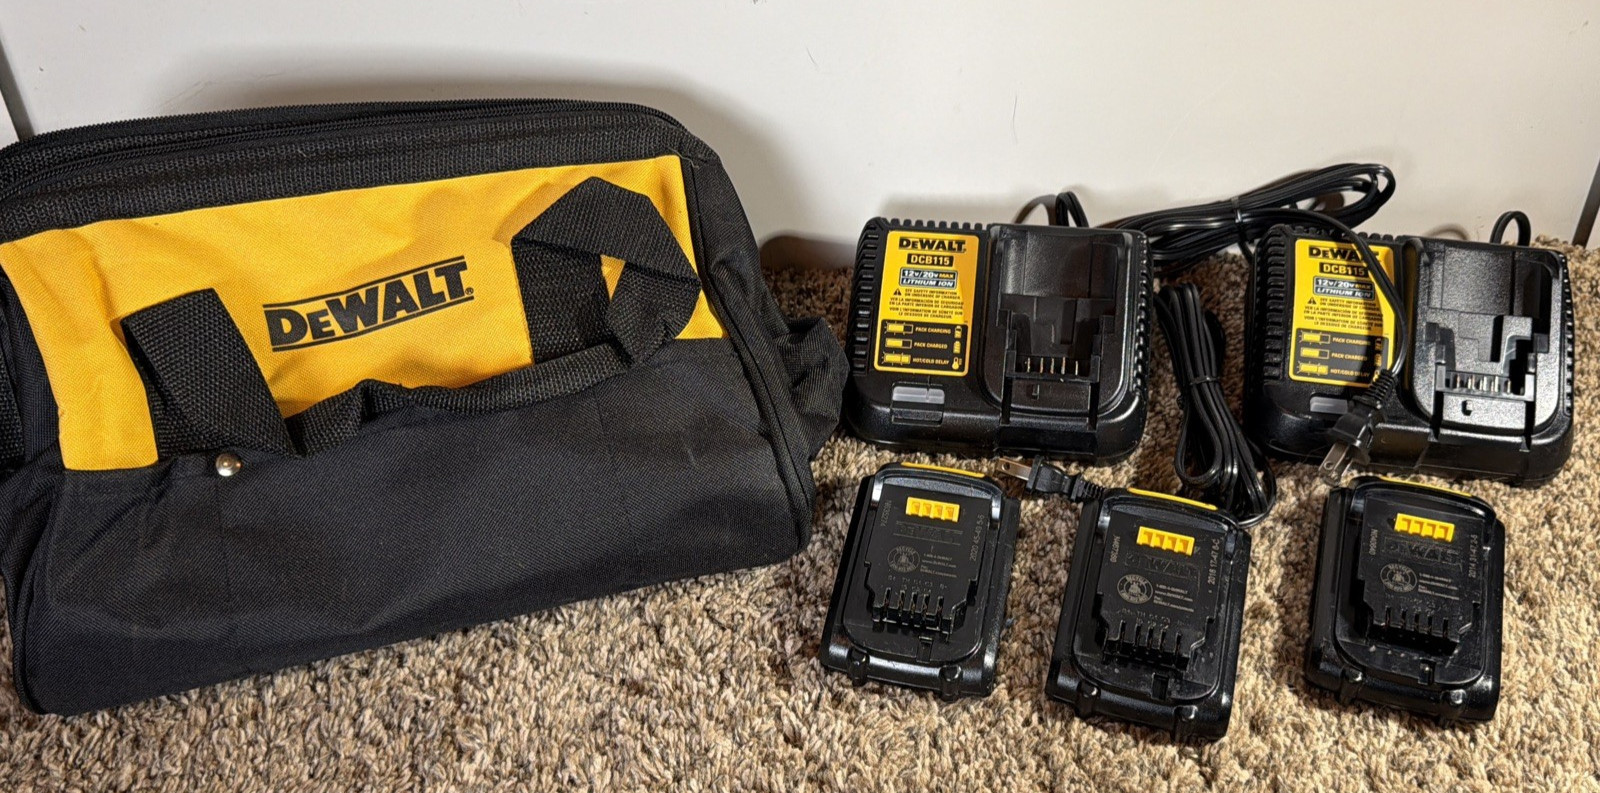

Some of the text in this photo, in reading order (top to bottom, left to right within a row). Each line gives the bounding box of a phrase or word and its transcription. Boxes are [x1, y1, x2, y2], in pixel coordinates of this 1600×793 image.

[911, 255, 950, 266] DCB115
[1323, 264, 1365, 276] DCB115
[1317, 287, 1353, 296] LITHIUM
[264, 261, 467, 346] DEWALT
